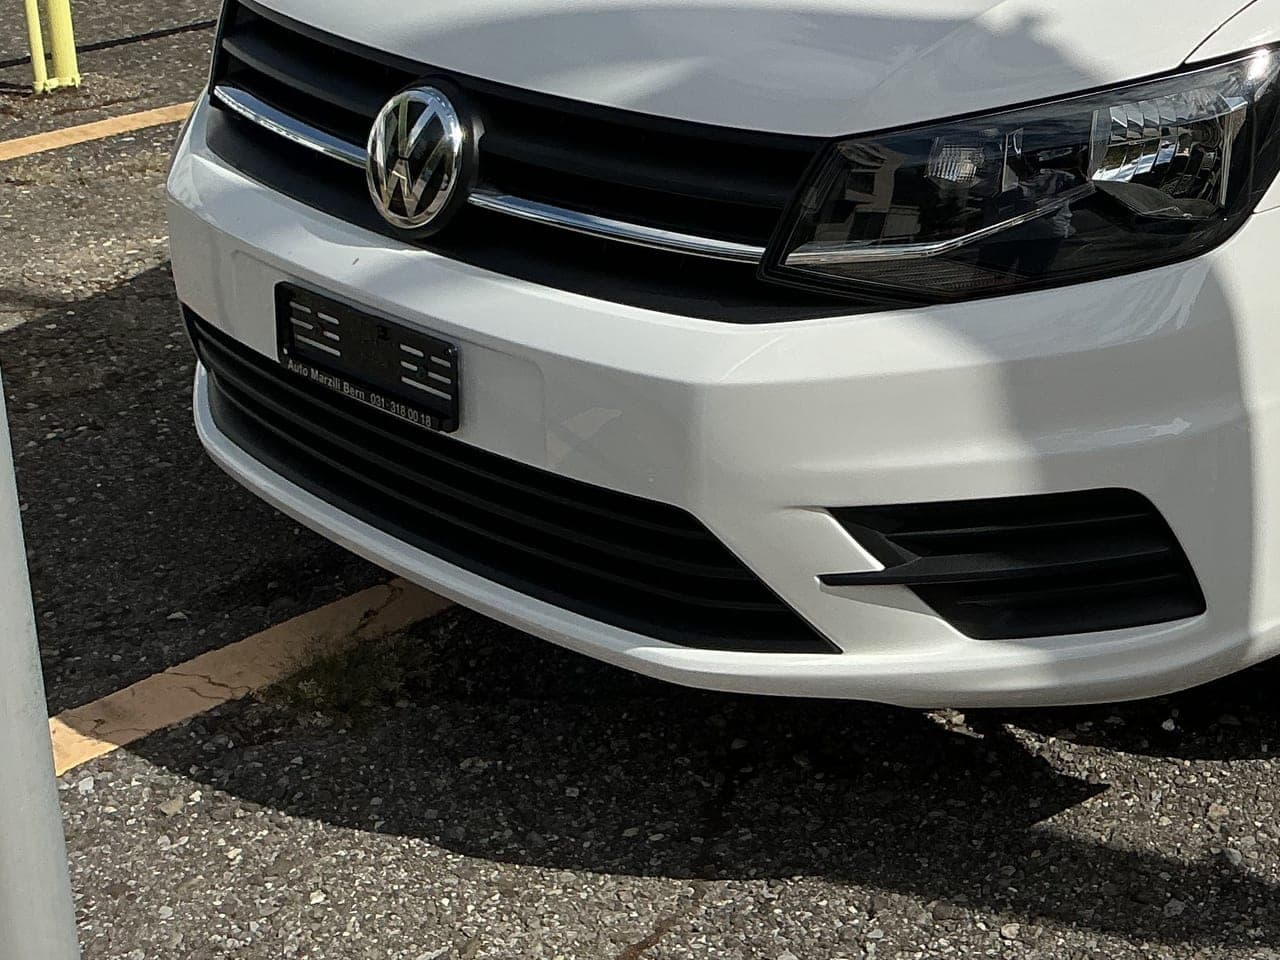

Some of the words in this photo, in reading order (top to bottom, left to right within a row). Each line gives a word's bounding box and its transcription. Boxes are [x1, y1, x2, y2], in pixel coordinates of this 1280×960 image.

[287, 359, 308, 378] Auto
[310, 367, 341, 391] Marzili
[343, 381, 365, 400] Bern
